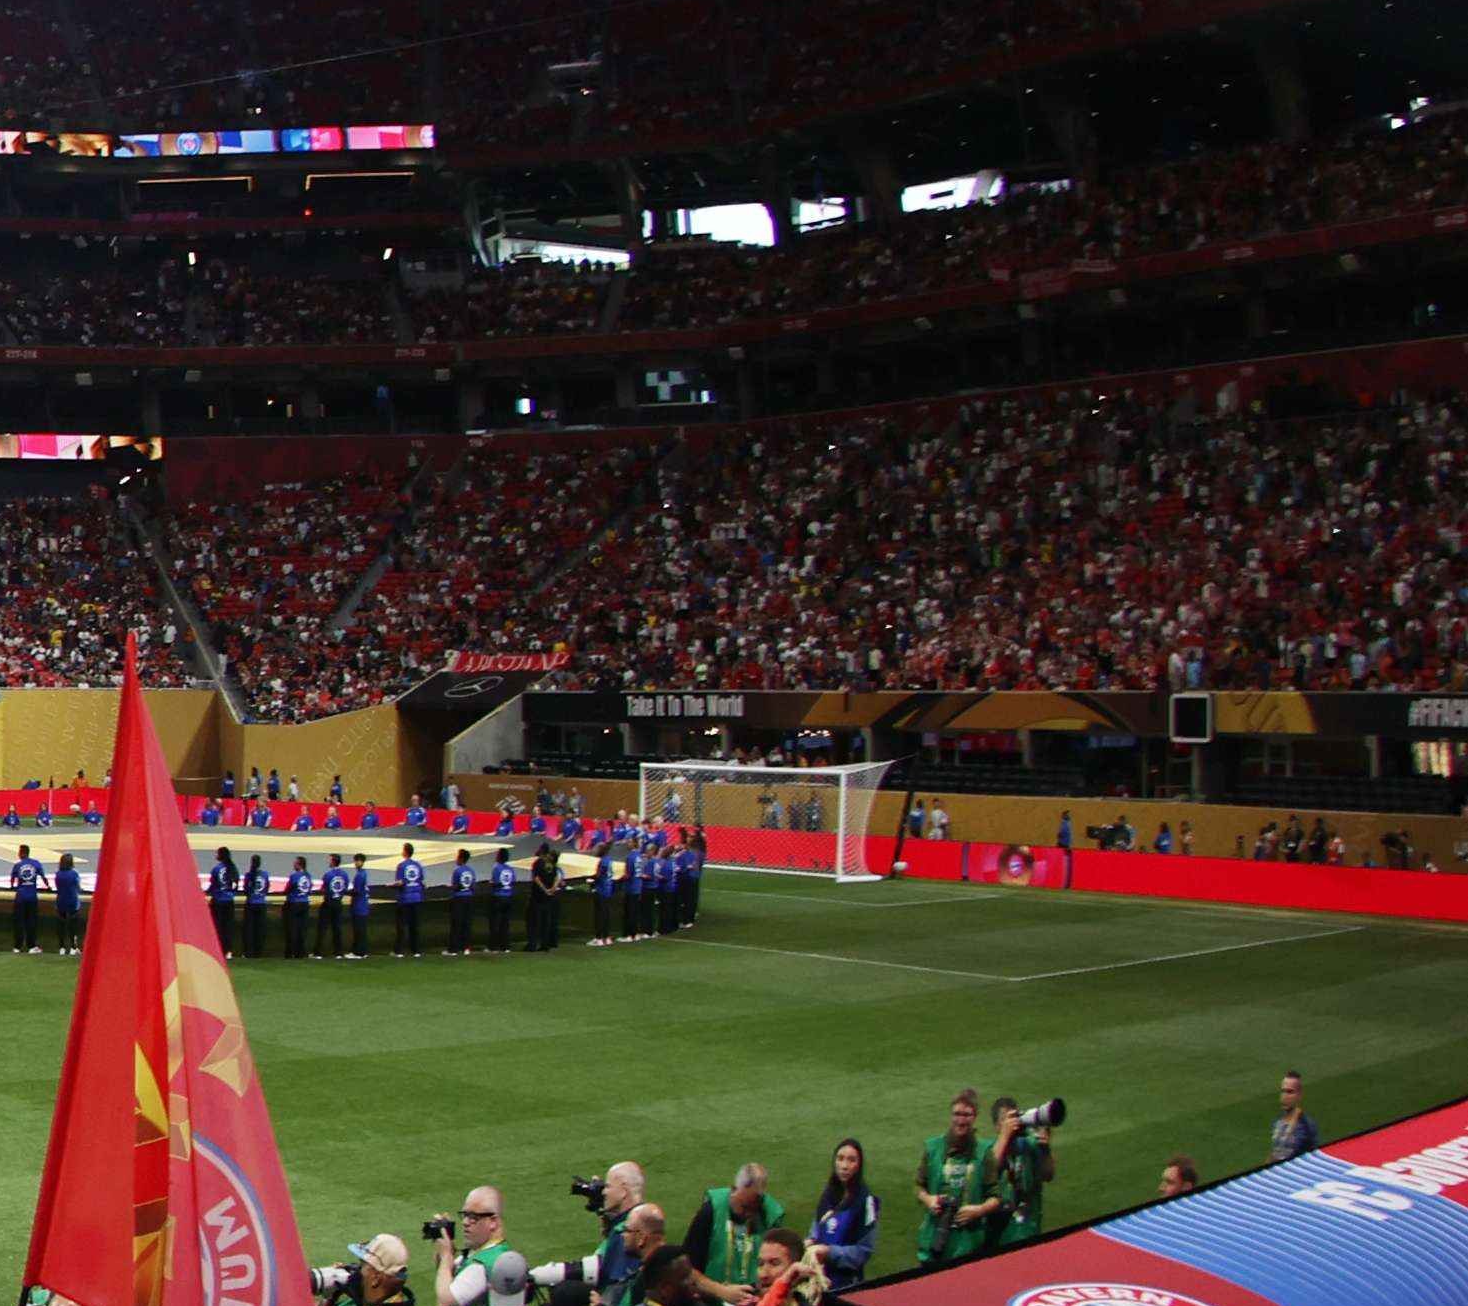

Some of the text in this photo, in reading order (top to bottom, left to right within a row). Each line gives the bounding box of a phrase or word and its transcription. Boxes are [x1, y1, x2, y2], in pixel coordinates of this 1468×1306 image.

[627, 695, 654, 716] Take
[685, 695, 705, 716] The
[706, 695, 744, 716] World
[1292, 1181, 1413, 1222] FC
